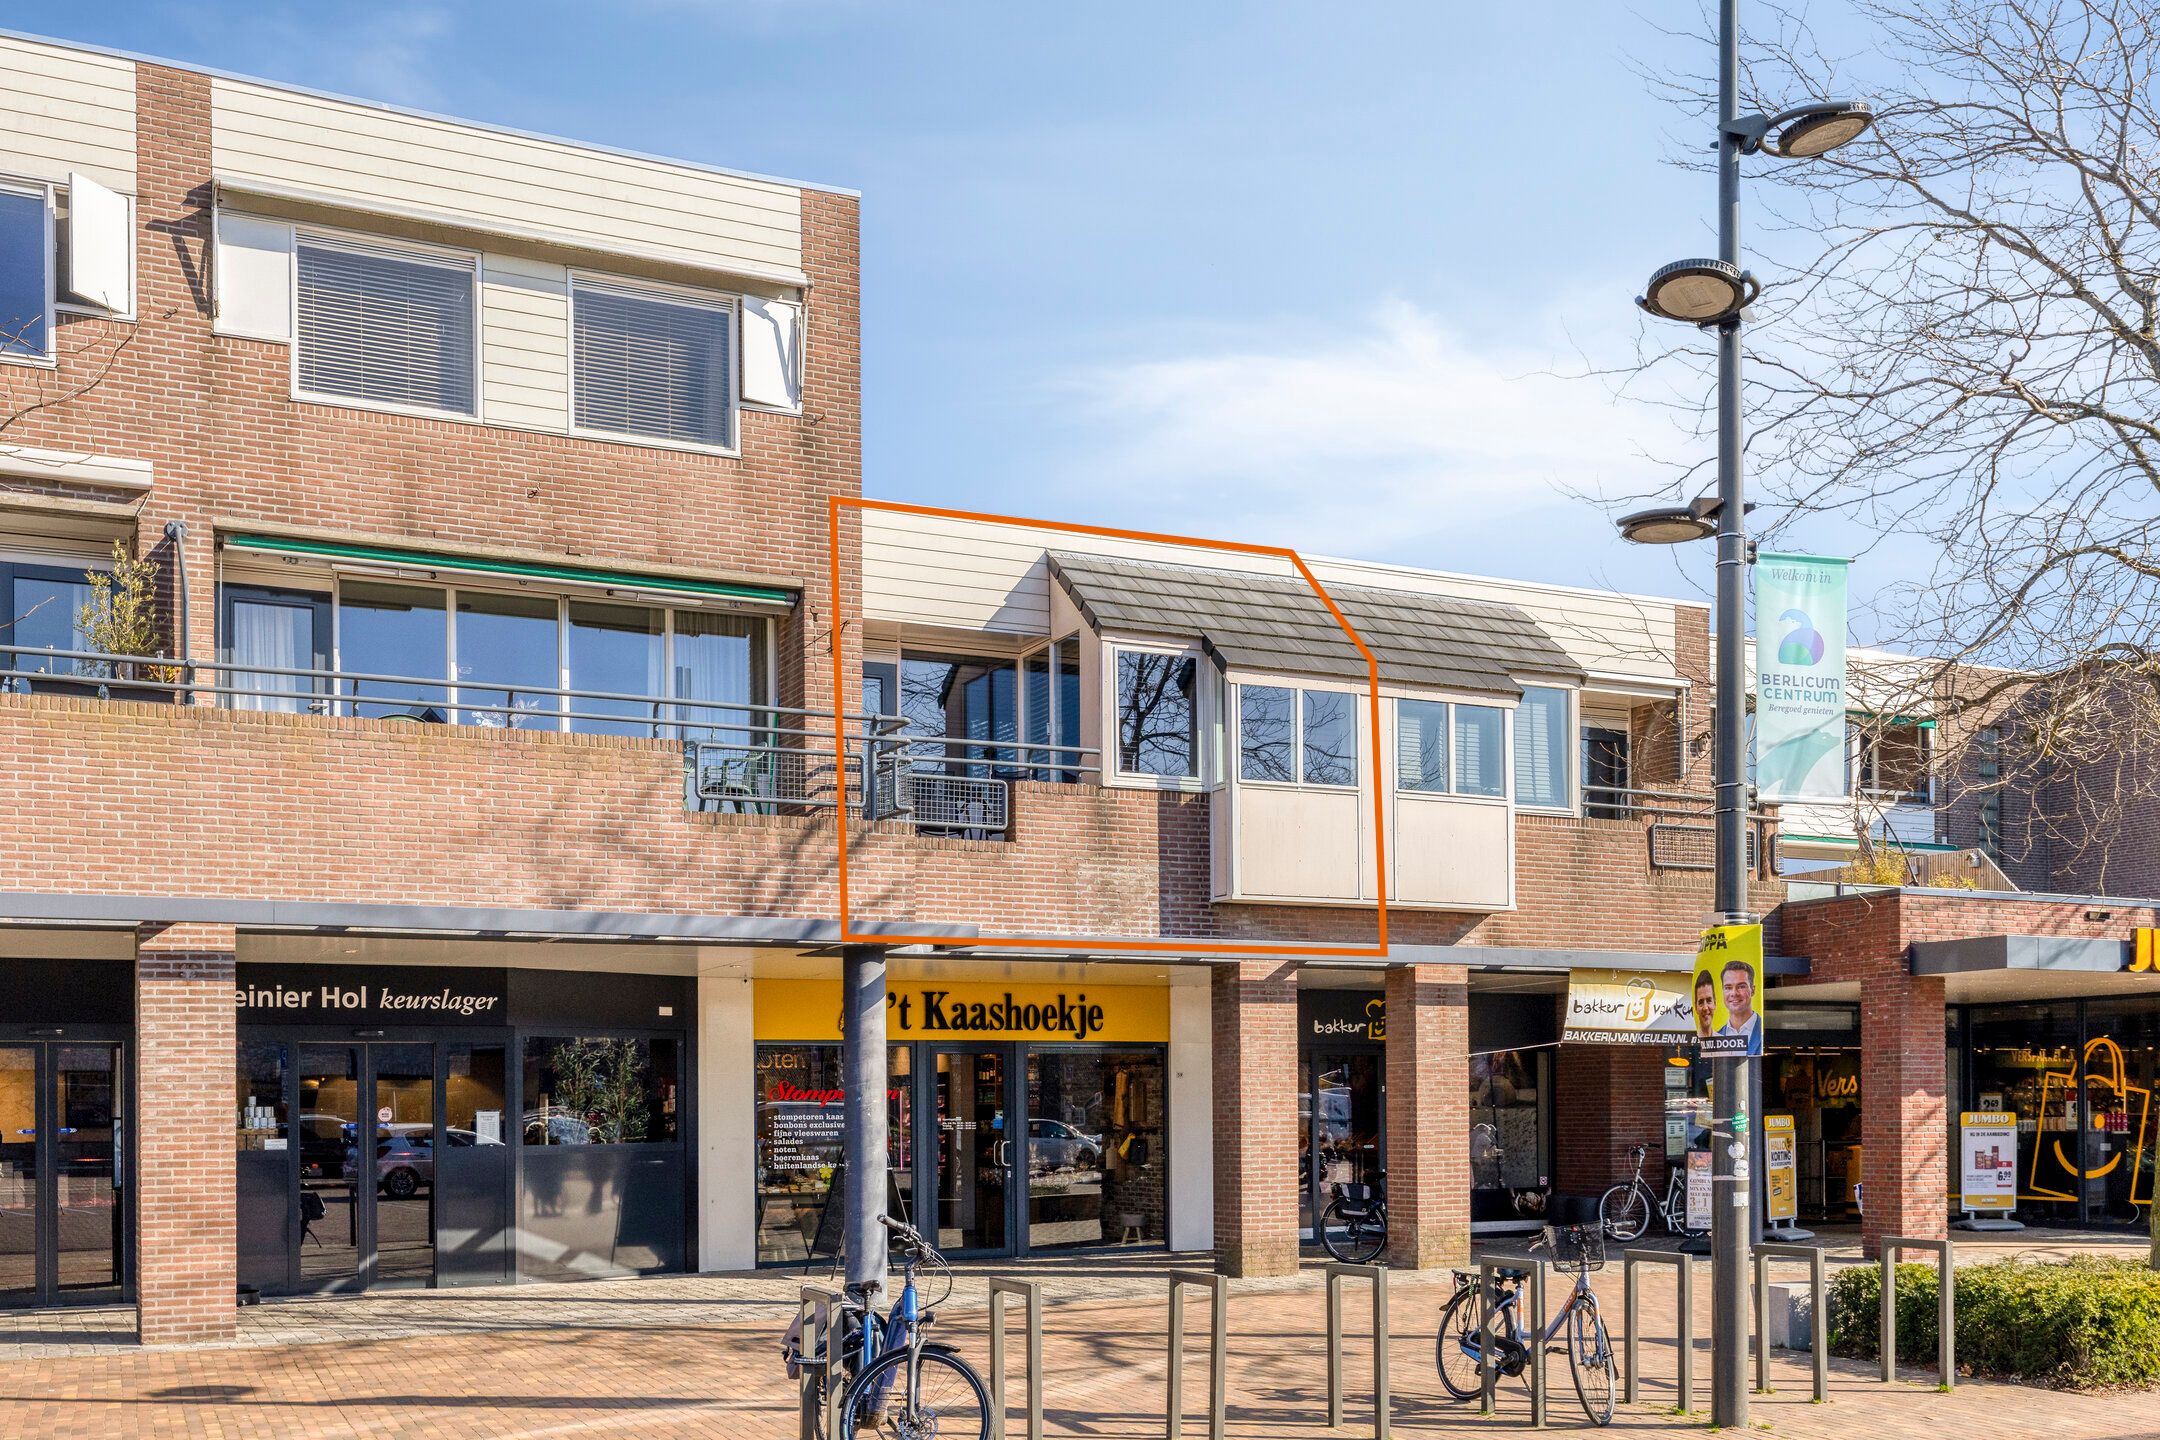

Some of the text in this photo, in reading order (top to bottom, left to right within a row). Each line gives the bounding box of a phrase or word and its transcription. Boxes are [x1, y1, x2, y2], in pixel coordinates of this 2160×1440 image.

[1771, 568, 1832, 584] Welkom in
[1761, 673, 1840, 690] BERLICUM
[1763, 687, 1838, 703] CENTRUM
[1768, 704, 1834, 716] Beregoed genieten
[2129, 927, 2160, 972] J
[235, 985, 498, 1015] einier Hol keurslager
[1573, 999, 1625, 1014] bakker
[1653, 1003, 1672, 1016] van
[921, 991, 1104, 1040] Kaashoekje
[1313, 1018, 1367, 1034] bakker
[1563, 1030, 1688, 1044] BAKKERIJVANKEULEN.NL
[1716, 1038, 1748, 1049] DOOR.
[1816, 1068, 1858, 1098] Vers
[773, 1113, 824, 1121] stompetoren
[1768, 1117, 1791, 1128] JUMBO
[1968, 1114, 2010, 1124] JUMBO
